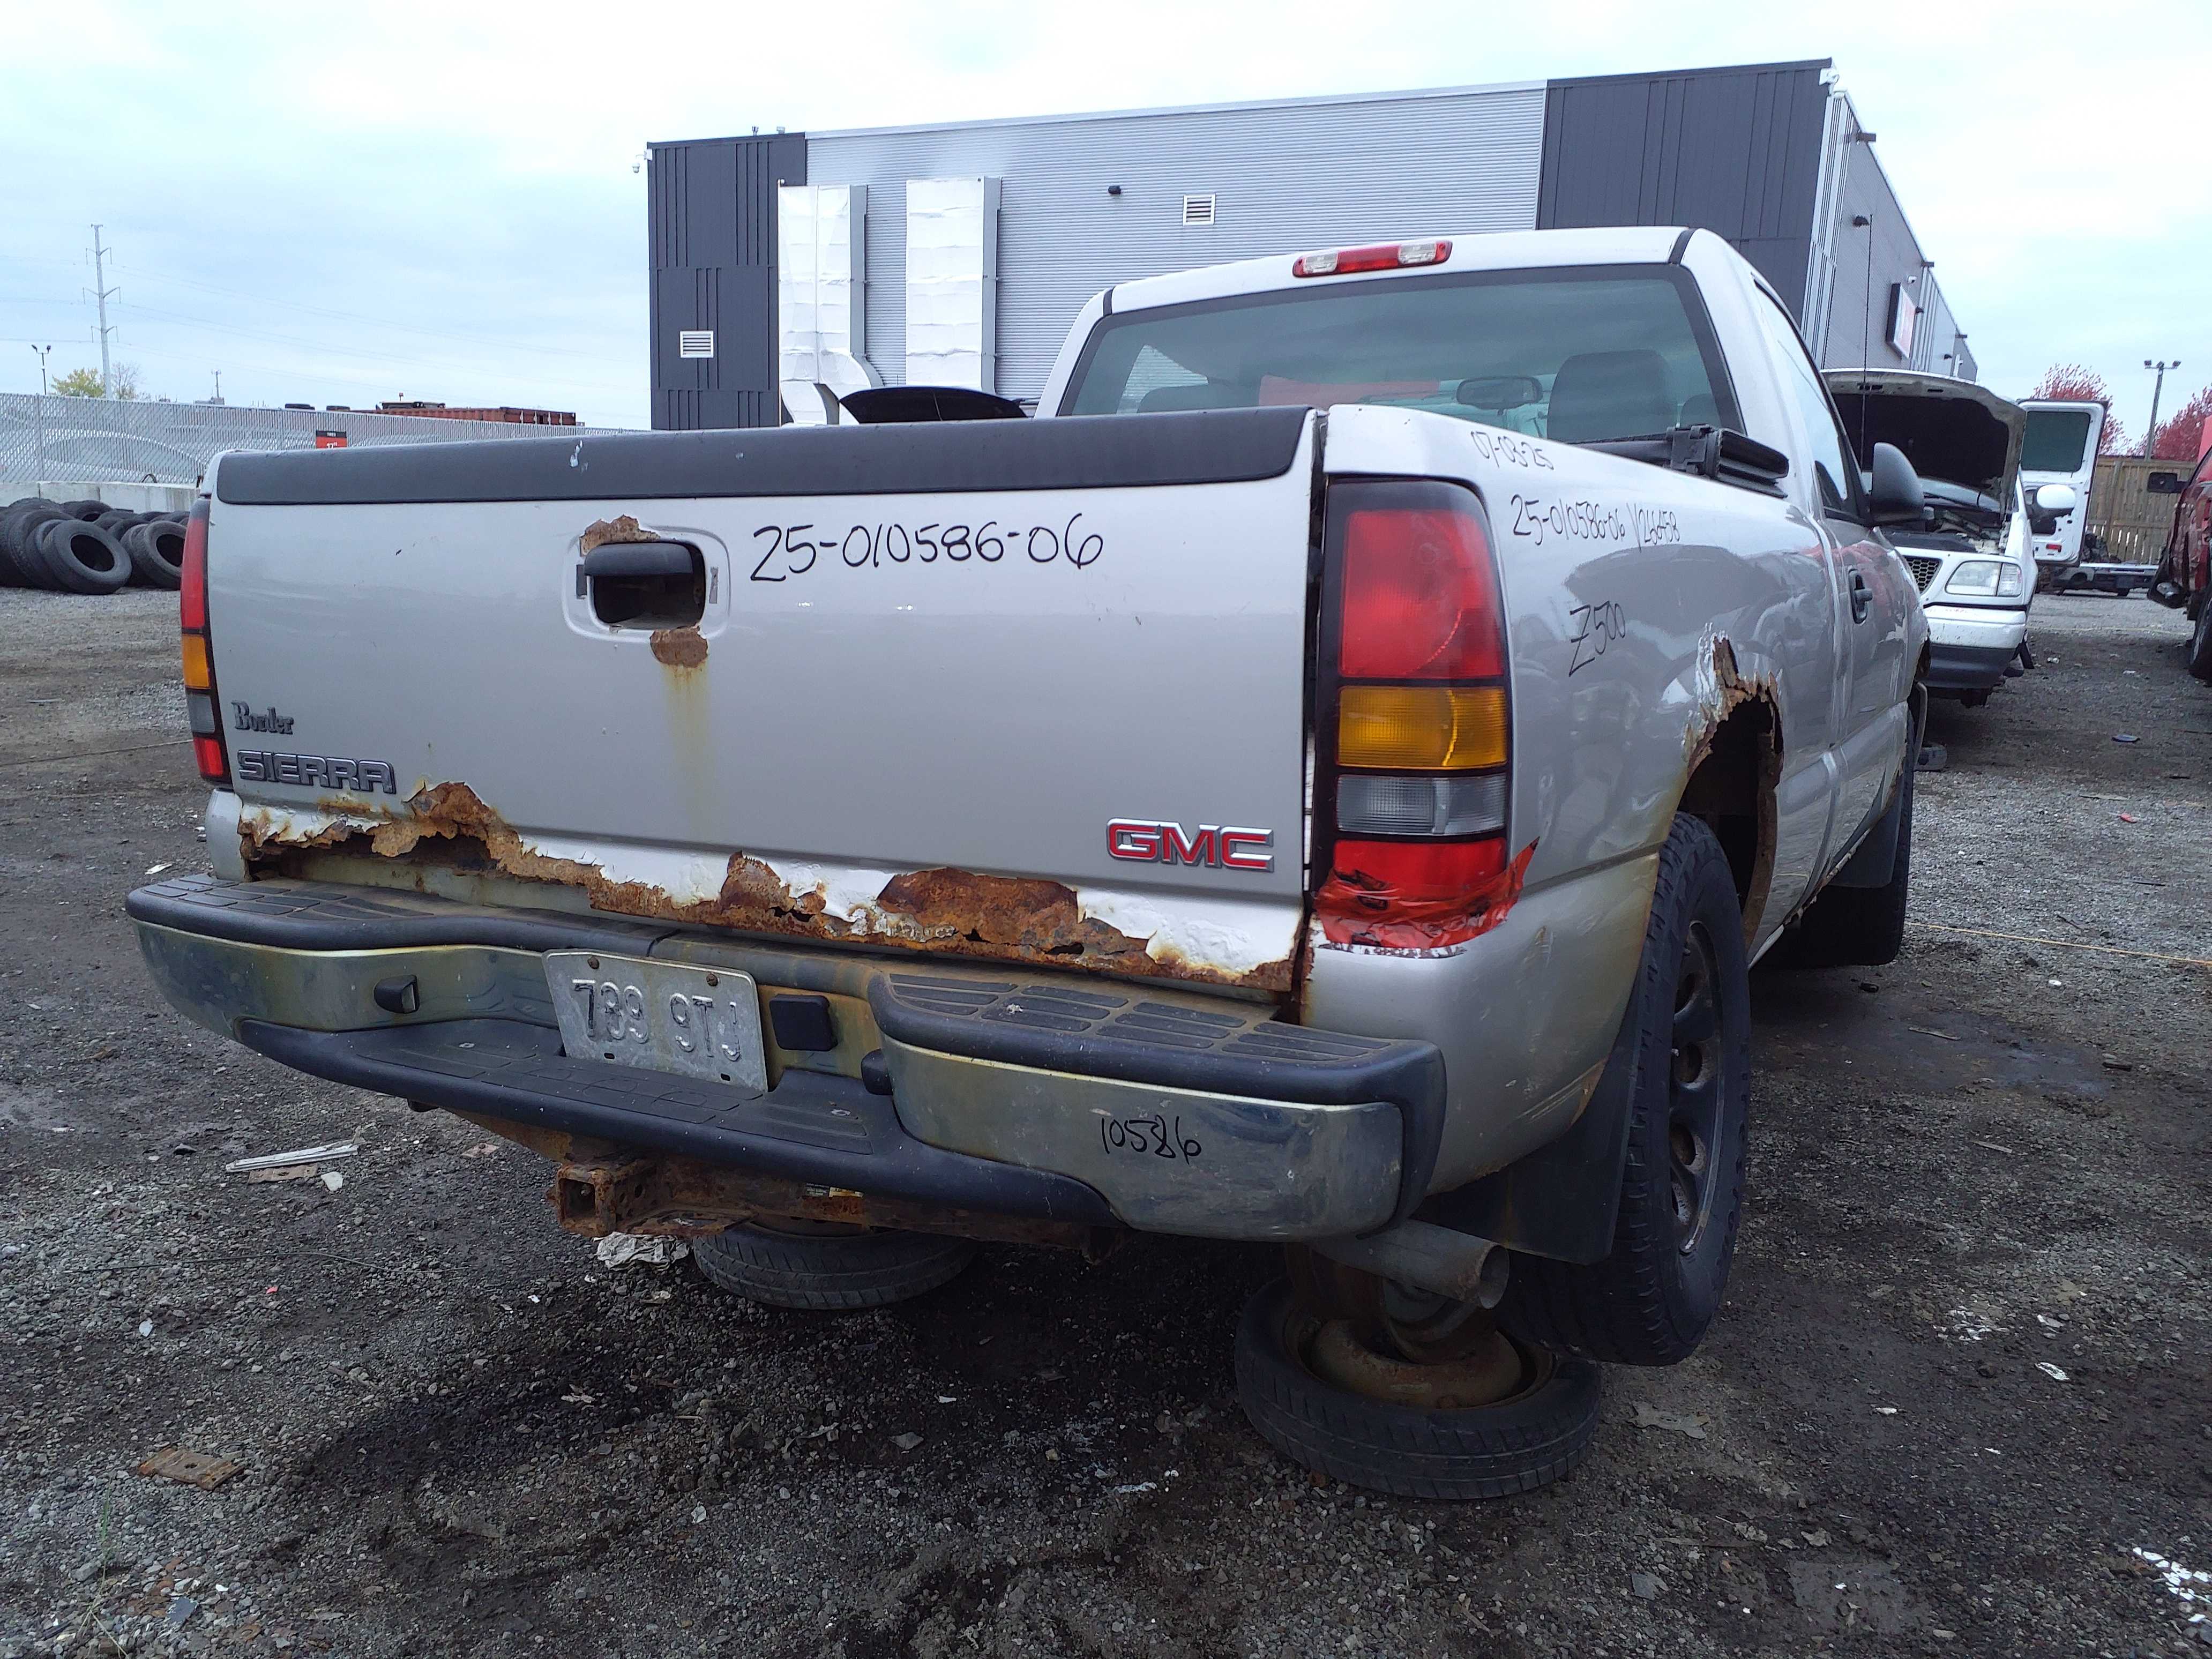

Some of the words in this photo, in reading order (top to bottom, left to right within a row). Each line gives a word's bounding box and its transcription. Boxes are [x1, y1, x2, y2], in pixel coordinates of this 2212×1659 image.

[1510, 494, 1625, 545] 25-010586-06
[750, 513, 1103, 582] 25-010586-06
[237, 749, 397, 795] SIERRA
[1107, 817, 1274, 873] GMC
[1101, 1114, 1202, 1165] 10586
